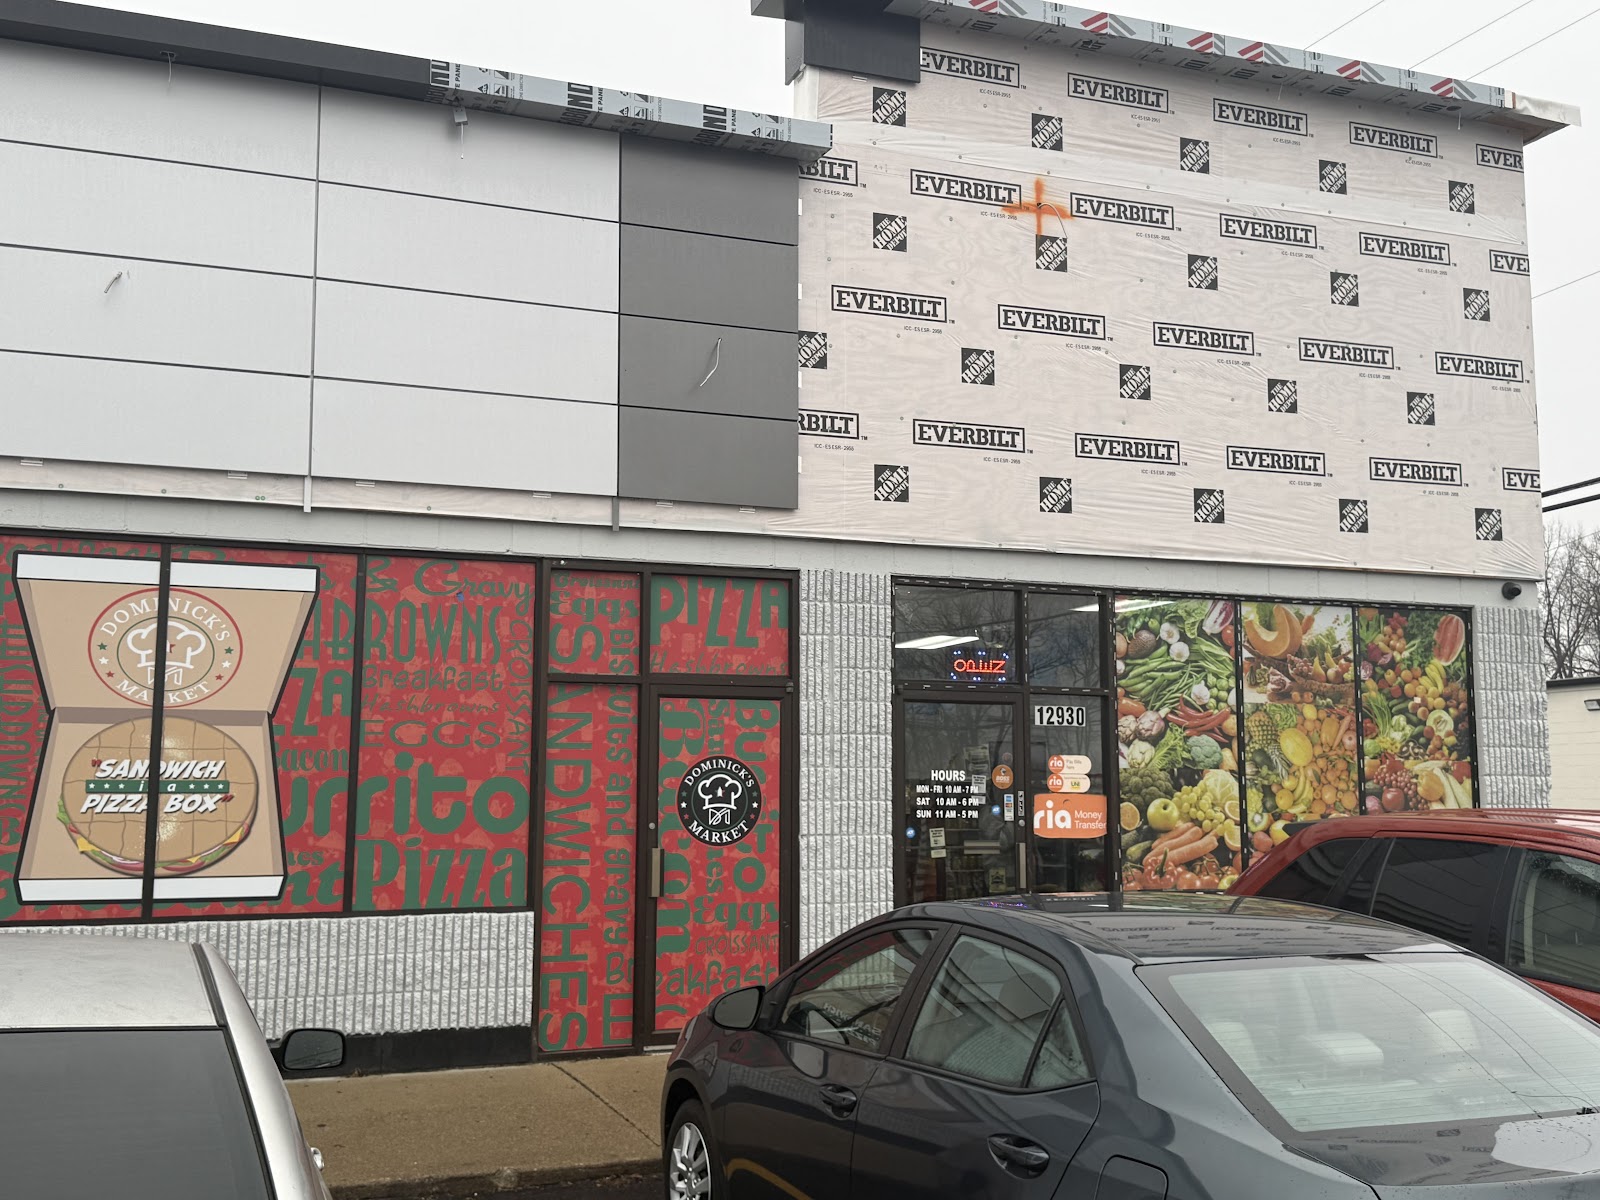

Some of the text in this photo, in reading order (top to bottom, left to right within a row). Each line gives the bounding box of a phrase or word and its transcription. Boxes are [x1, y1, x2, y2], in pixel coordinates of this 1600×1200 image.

[876, 91, 891, 107] THE
[1073, 77, 1163, 108] EVERBILT
[873, 87, 907, 126] HOME
[886, 102, 907, 127] DEPOT
[1218, 103, 1303, 131] EVERBILT
[1032, 113, 1063, 151] HOME
[1035, 117, 1048, 132] THE
[1044, 127, 1063, 152] DEPOT
[1183, 140, 1196, 155] THE
[1354, 126, 1432, 153] EVERBILT
[1180, 137, 1210, 173] HOME
[1192, 151, 1210, 174] DEPOT
[915, 174, 1016, 204] EVERBILT
[1076, 197, 1169, 225] EVERBILT
[873, 212, 908, 251] HOME
[876, 216, 891, 232] THE
[1224, 218, 1312, 244] EVERBILT
[887, 227, 908, 252] DEPOT
[1039, 237, 1052, 253] THE
[1364, 237, 1445, 261] EVERBILT
[1036, 234, 1067, 271] HOME
[1048, 248, 1067, 272] DEPOT
[1191, 257, 1204, 272] THE
[1188, 254, 1218, 290] HOME
[1200, 268, 1218, 291] DEPOT
[836, 290, 942, 318] EVERBILT
[1003, 309, 1101, 335] EVERBILT
[1158, 327, 1249, 351] EVERBILT
[805, 346, 827, 368] DEPOT
[964, 351, 979, 367] THE
[1304, 342, 1389, 365] EVERBILT
[961, 348, 995, 385] HOME
[974, 362, 995, 386] DEPOT
[1122, 367, 1136, 382] THE
[1440, 356, 1519, 379] EVERBILT
[1119, 364, 1151, 399] HOME
[1131, 377, 1151, 400] DEPOT
[1270, 381, 1283, 396] THE
[1267, 378, 1297, 413] HOME
[1279, 391, 1297, 414] DEPOT
[918, 424, 1020, 448] EVERBILT
[1080, 438, 1175, 460] EVERBILT
[1231, 450, 1321, 472] EVERBILT
[874, 464, 909, 501] HOME
[878, 467, 892, 483] THE
[1374, 462, 1457, 482] EVERBILT
[888, 478, 909, 502] DEPOT
[1039, 477, 1072, 513] HOME
[1042, 480, 1056, 495] THE
[1197, 491, 1210, 506] THE
[1052, 491, 1072, 514] DEPOT
[1194, 488, 1225, 523] HOME
[1206, 501, 1225, 524] DEPOT
[1339, 499, 1368, 532] HOME
[1475, 508, 1503, 540] HOME
[414, 559, 534, 617] Gravy
[550, 590, 640, 624] Eggs
[651, 575, 789, 648] PIZZA
[651, 650, 788, 676] Hashbrowns
[362, 664, 503, 692] Breakfast
[116, 679, 212, 704] MAKET
[361, 693, 500, 714] Hashbrowns
[506, 619, 533, 776] CROISSANT
[1037, 706, 1085, 726] 12930
[360, 720, 502, 749] EGGS
[684, 758, 755, 788] DOMINICK'S
[1050, 757, 1063, 767] ria
[931, 769, 966, 782] HOURS
[1049, 776, 1062, 786] ria
[916, 785, 930, 793] MON
[933, 785, 942, 793] FRI
[606, 773, 635, 836] and
[916, 797, 930, 806] SAT
[936, 797, 944, 806] 10
[945, 797, 957, 806] AM
[968, 797, 979, 806] PM
[916, 810, 931, 818] SUN
[935, 810, 944, 818] 11
[945, 810, 956, 818] AM
[968, 810, 979, 818] PM
[1034, 800, 1071, 829] ria
[1075, 810, 1102, 821] Money
[1075, 820, 1106, 829] Transfer
[688, 819, 750, 844] MARKET
[351, 836, 528, 911] Pizza
[602, 849, 632, 945] gravy
[693, 895, 779, 931] Eggs
[694, 934, 779, 956] CROISSANT
